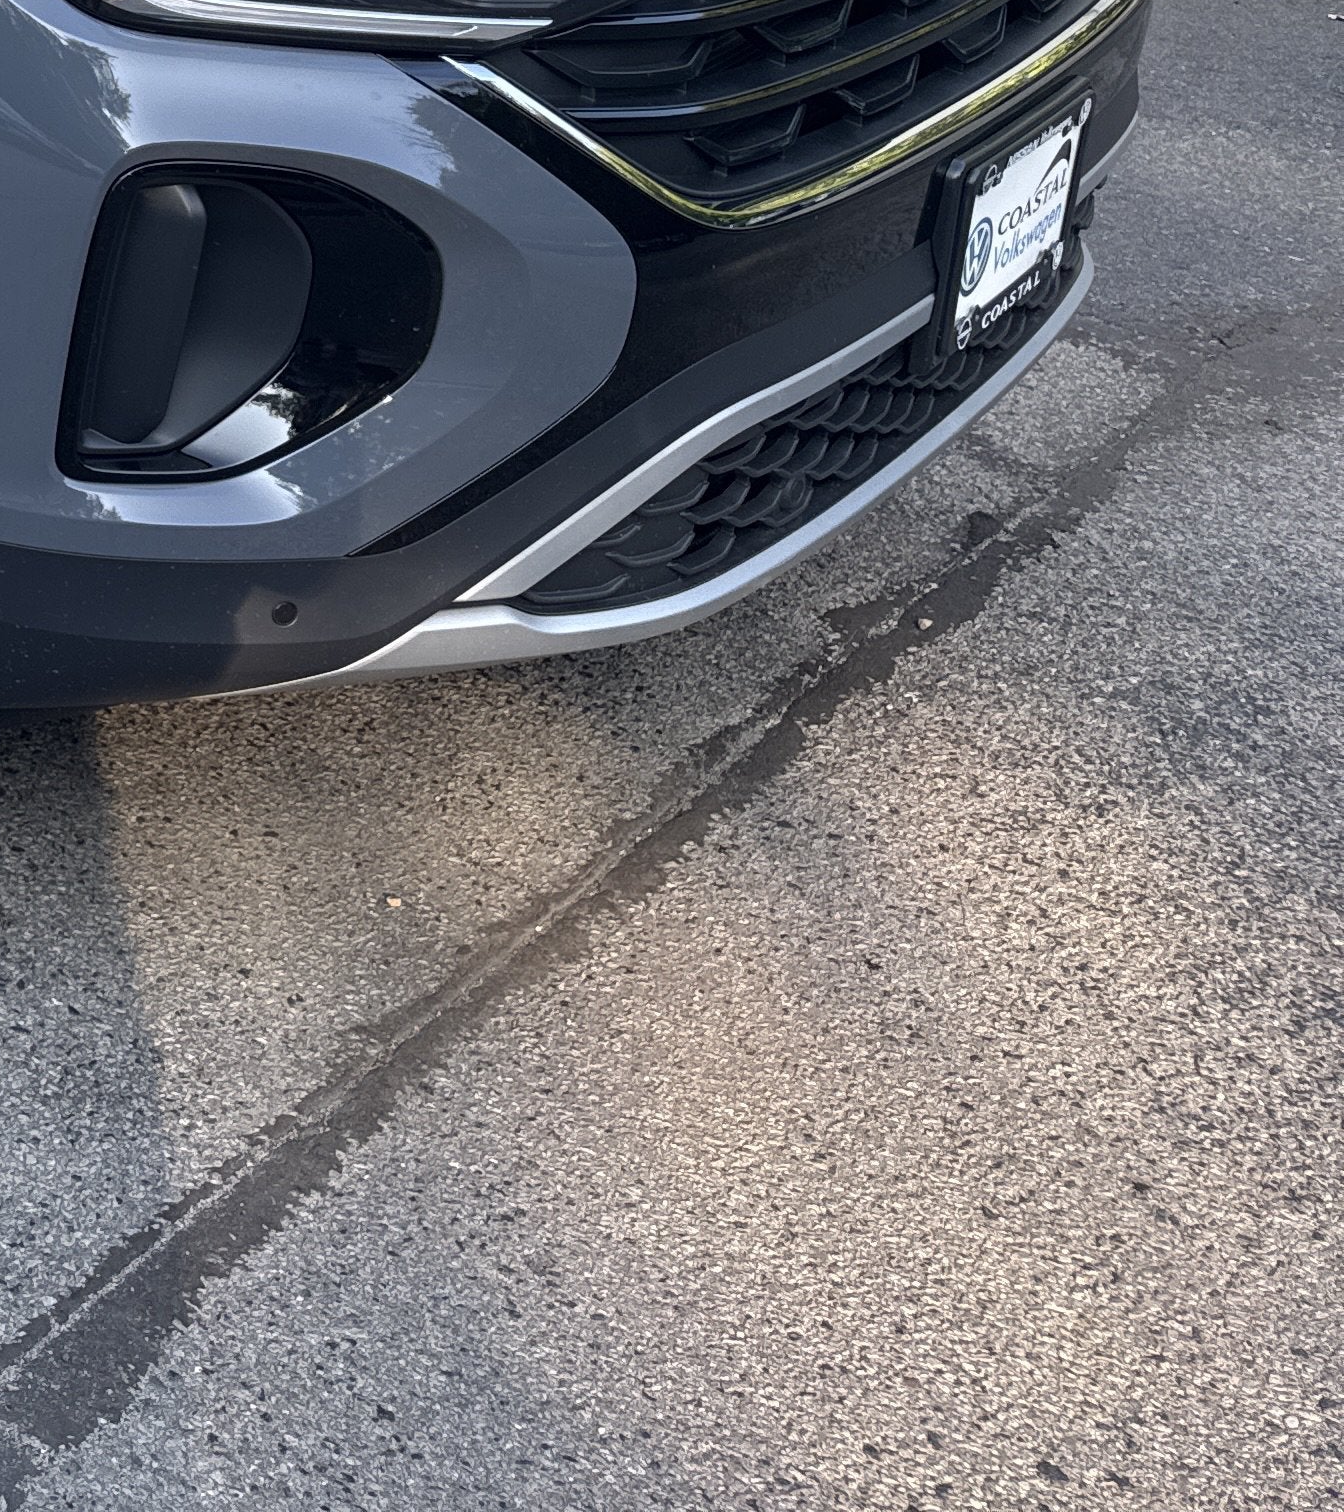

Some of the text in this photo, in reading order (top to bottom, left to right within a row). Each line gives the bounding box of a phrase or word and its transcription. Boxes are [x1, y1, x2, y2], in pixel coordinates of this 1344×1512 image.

[998, 168, 1069, 236] COASTAL
[994, 203, 1062, 271] Volkswagen
[981, 270, 1041, 329] COASTAL
